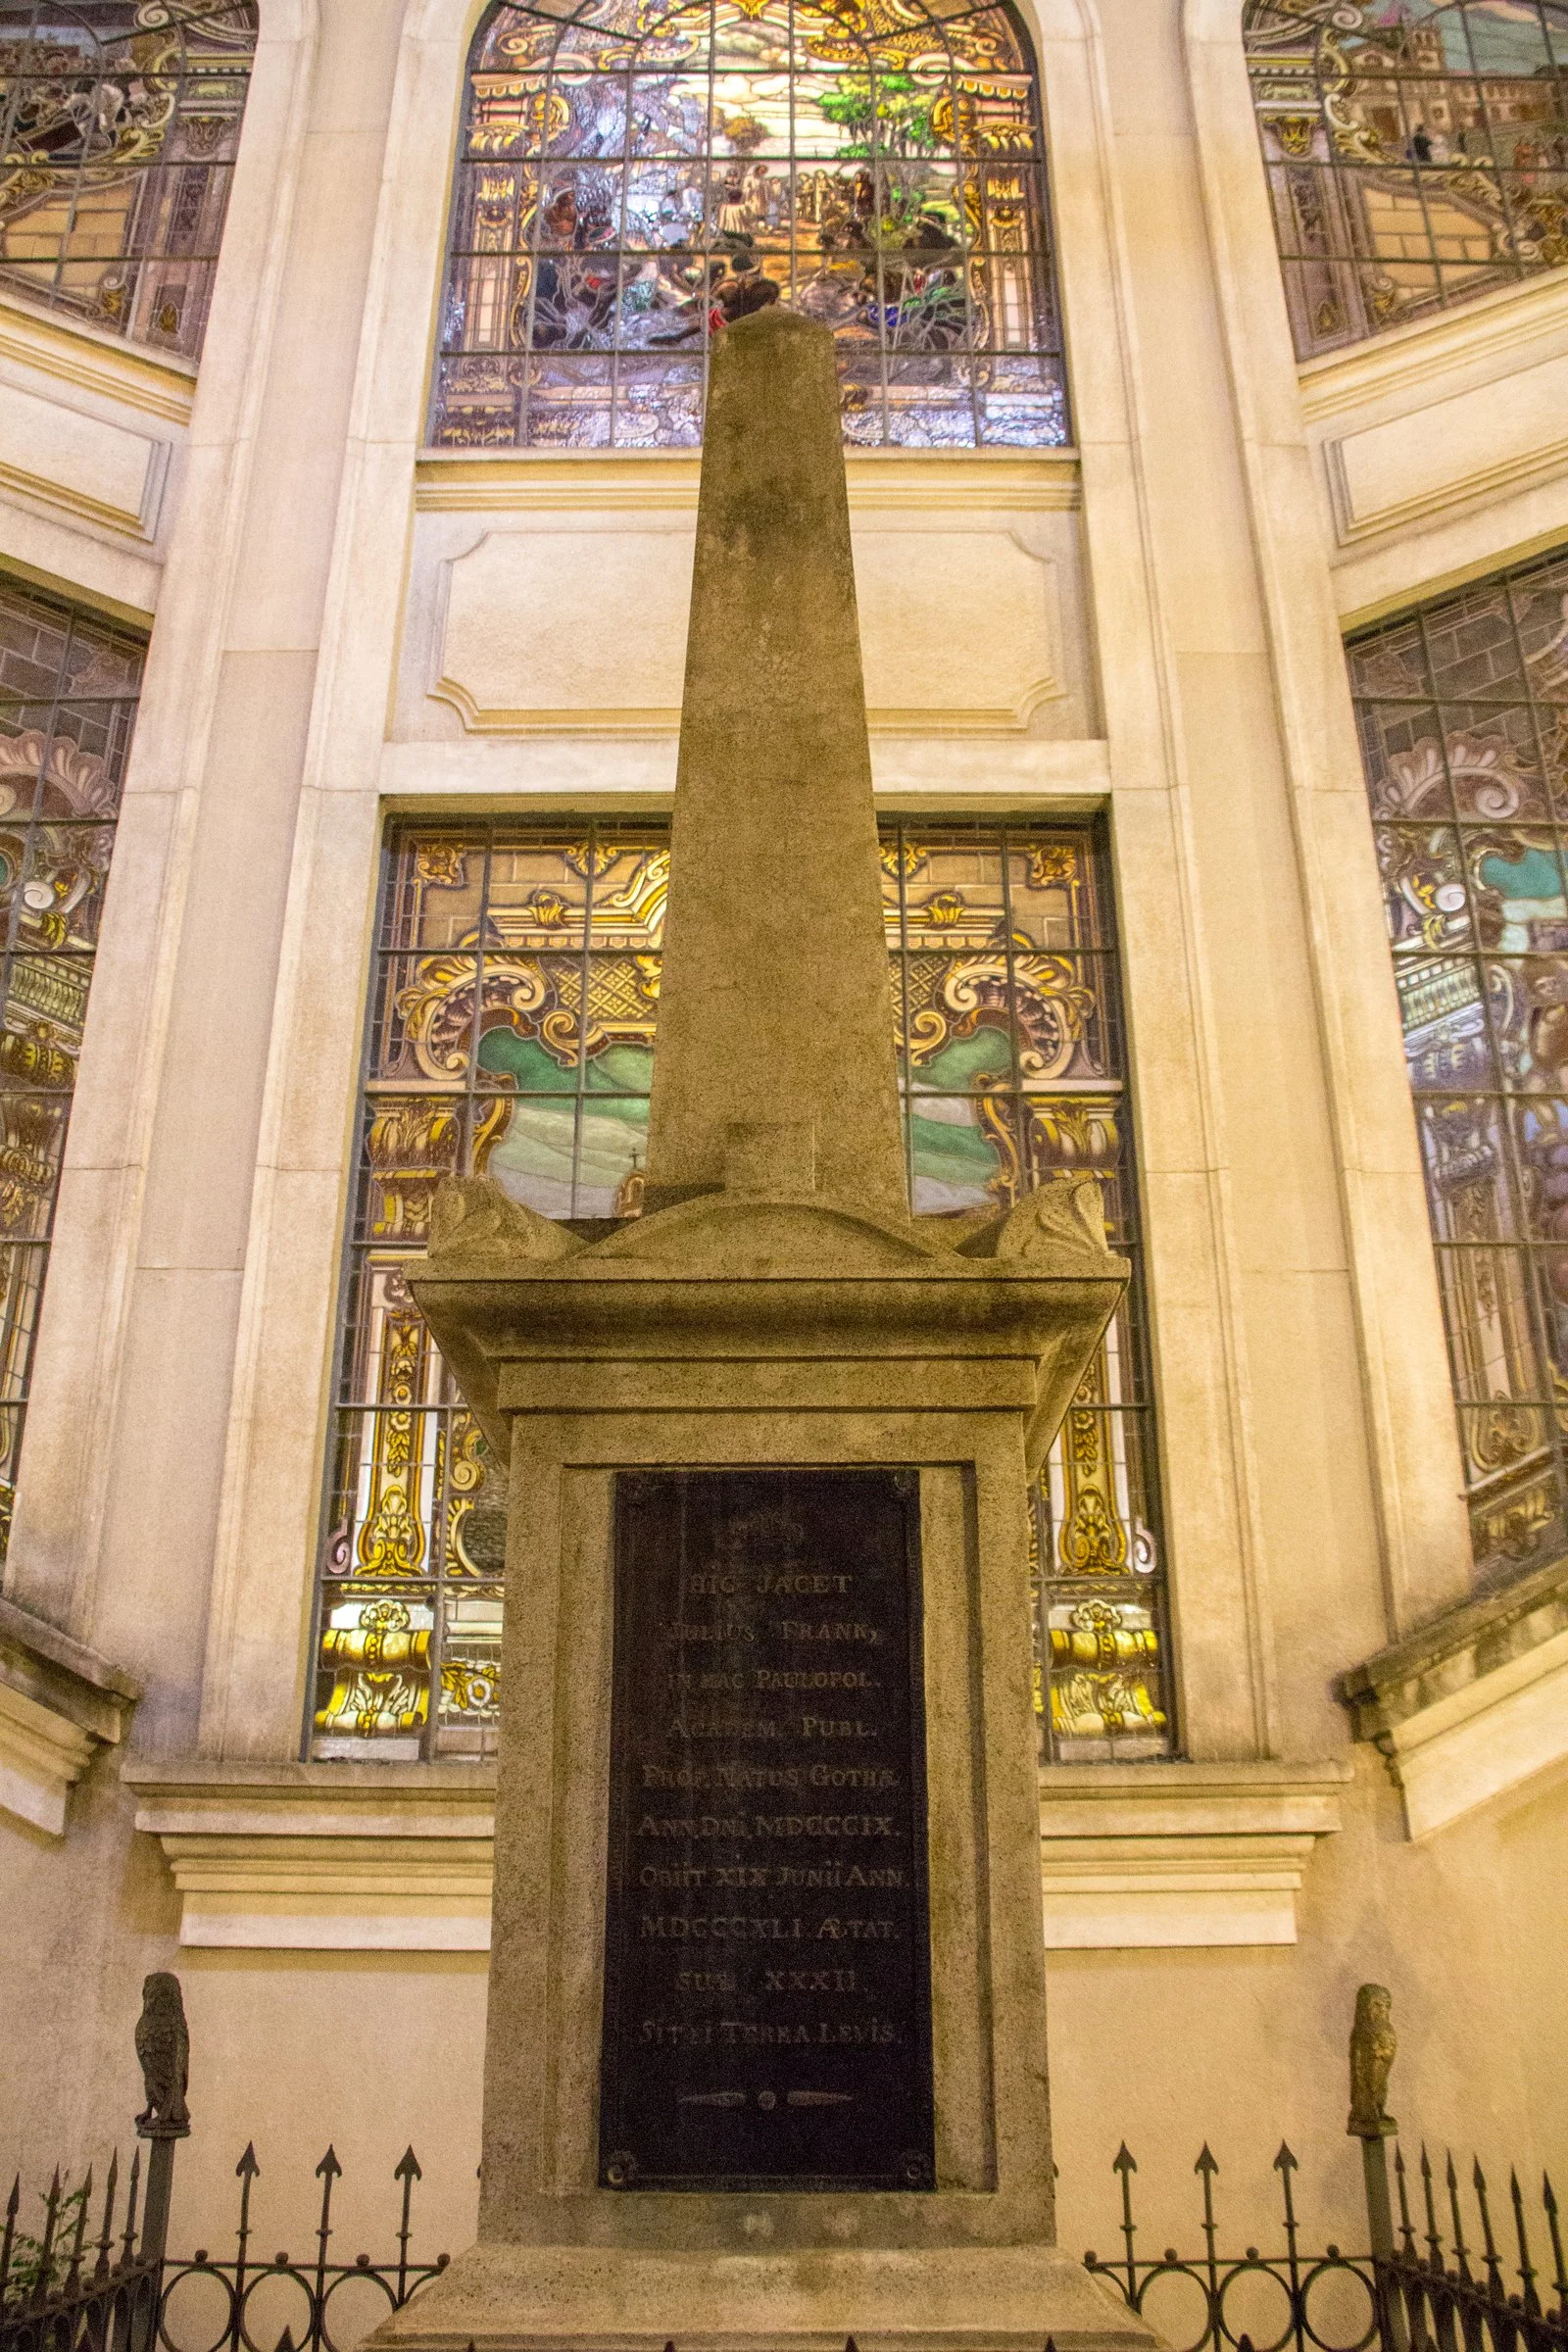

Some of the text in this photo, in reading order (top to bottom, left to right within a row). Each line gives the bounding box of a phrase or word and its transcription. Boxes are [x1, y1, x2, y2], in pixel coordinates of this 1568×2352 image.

[690, 1574, 854, 1594] HIC JACET
[802, 1717, 878, 1738] PUBL.
[715, 1867, 769, 1887] XIX
